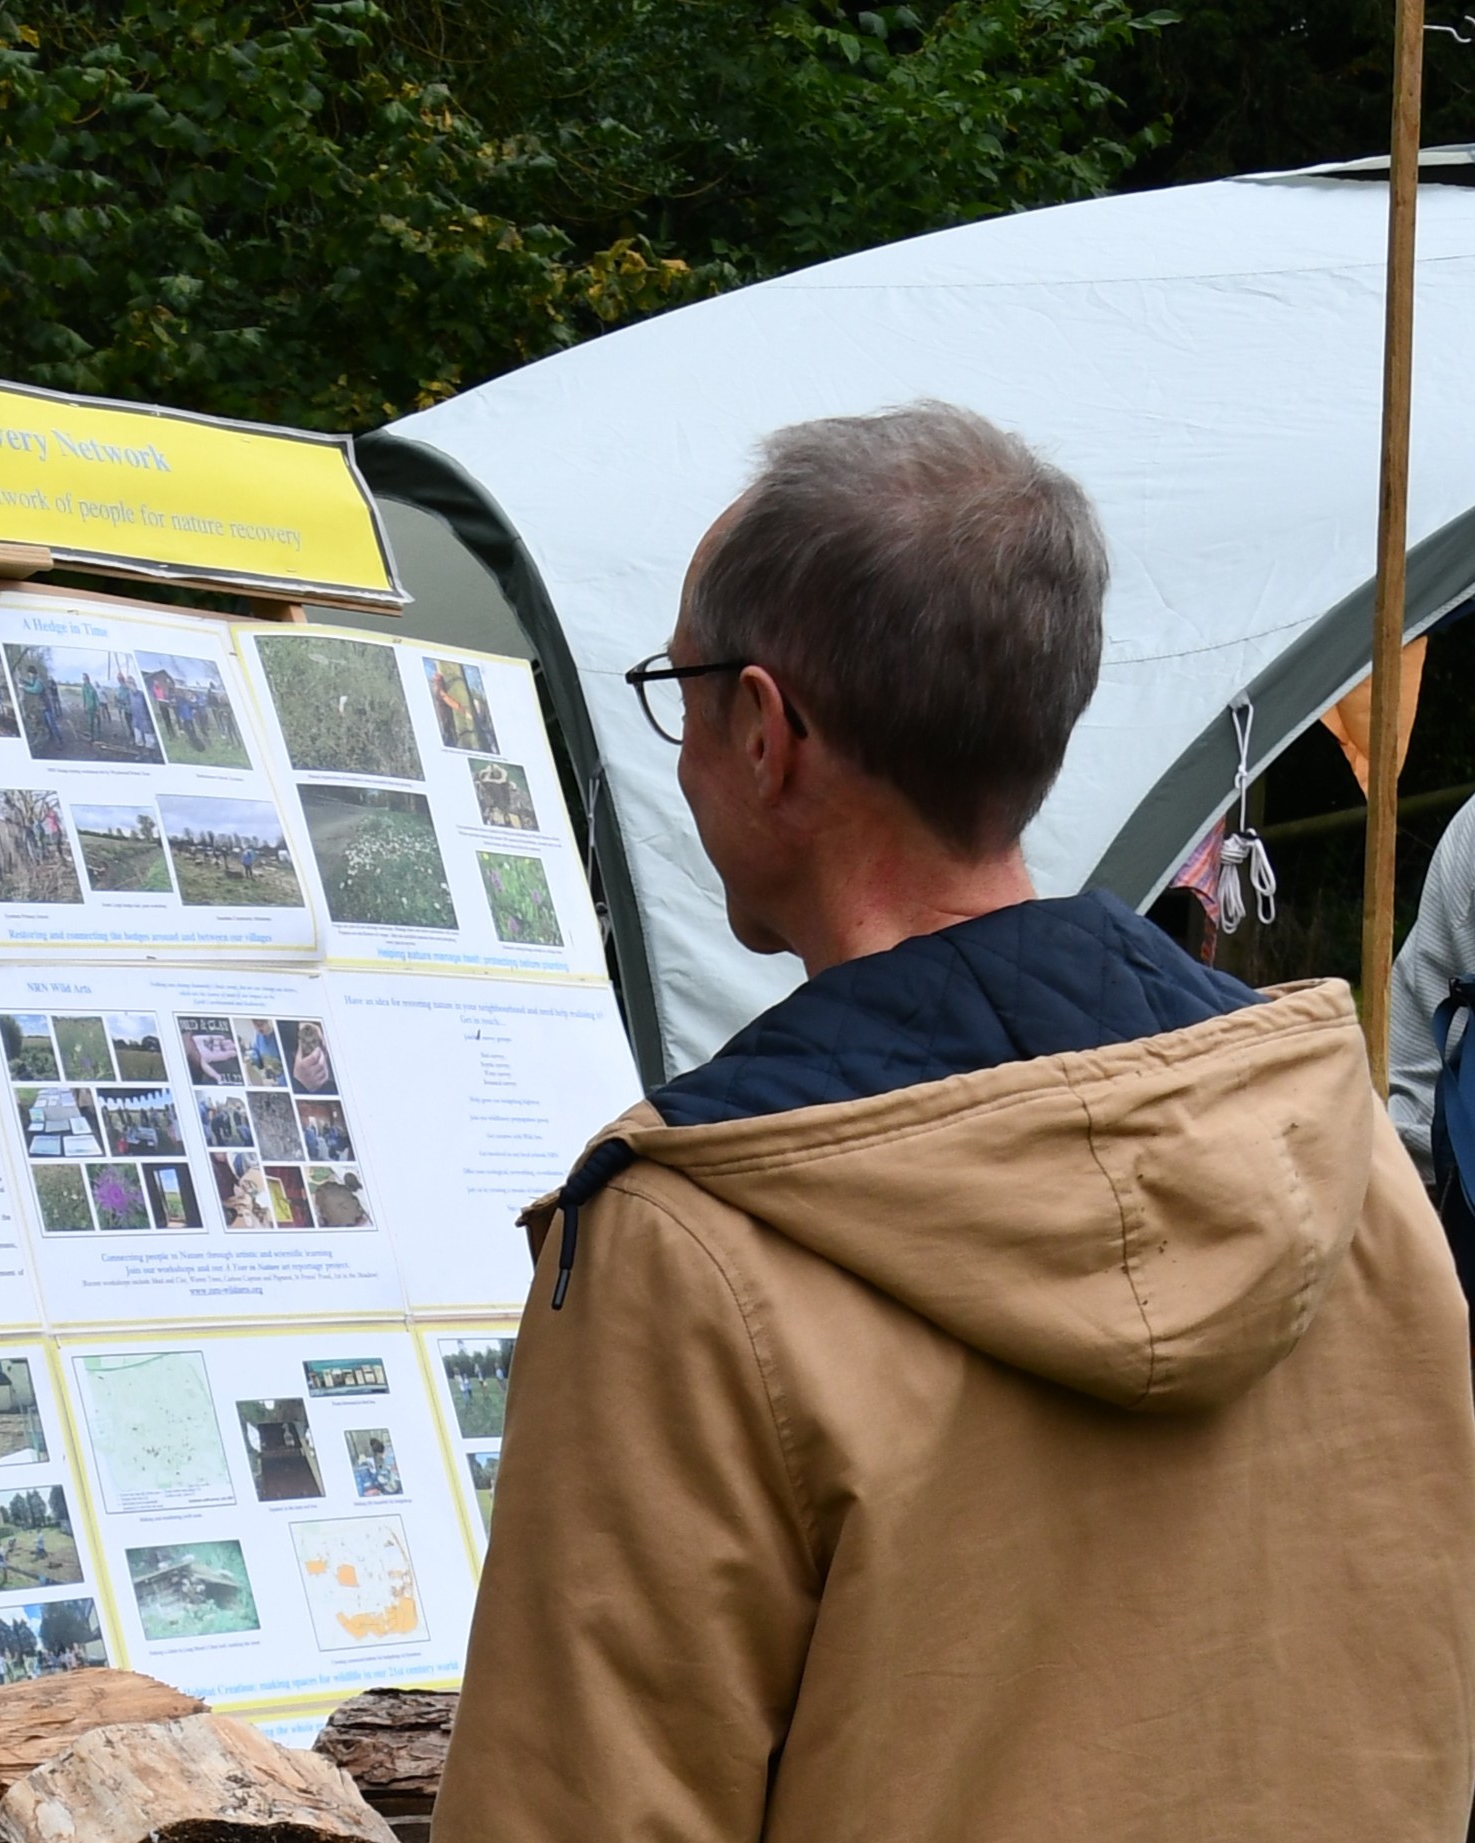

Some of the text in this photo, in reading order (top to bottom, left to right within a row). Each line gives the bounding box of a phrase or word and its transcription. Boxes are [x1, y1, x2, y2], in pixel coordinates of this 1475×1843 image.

[51, 429, 170, 474] Network
[55, 496, 72, 515] of
[79, 503, 134, 527] people
[140, 506, 165, 528] for
[171, 513, 223, 536] nature
[229, 524, 301, 552] recovery
[23, 618, 107, 638] A Hedge in Time
[9, 930, 47, 942] Restoring
[50, 930, 64, 940] and
[66, 930, 108, 942] connecting
[110, 930, 121, 940] the
[124, 930, 149, 942] hedges
[152, 931, 178, 940] around
[181, 931, 195, 941] and
[197, 931, 229, 941] between
[245, 931, 271, 943] villages
[26, 982, 91, 993] NRN Wild Arts
[259, 1678, 289, 1690] making
[292, 1677, 316, 1688] spaces
[319, 1673, 330, 1684] for
[333, 1669, 360, 1682] wildlife
[362, 1668, 370, 1679] in
[373, 1670, 386, 1678] our
[389, 1665, 403, 1676] 21st
[405, 1663, 433, 1675] century
[437, 1659, 458, 1671] world
